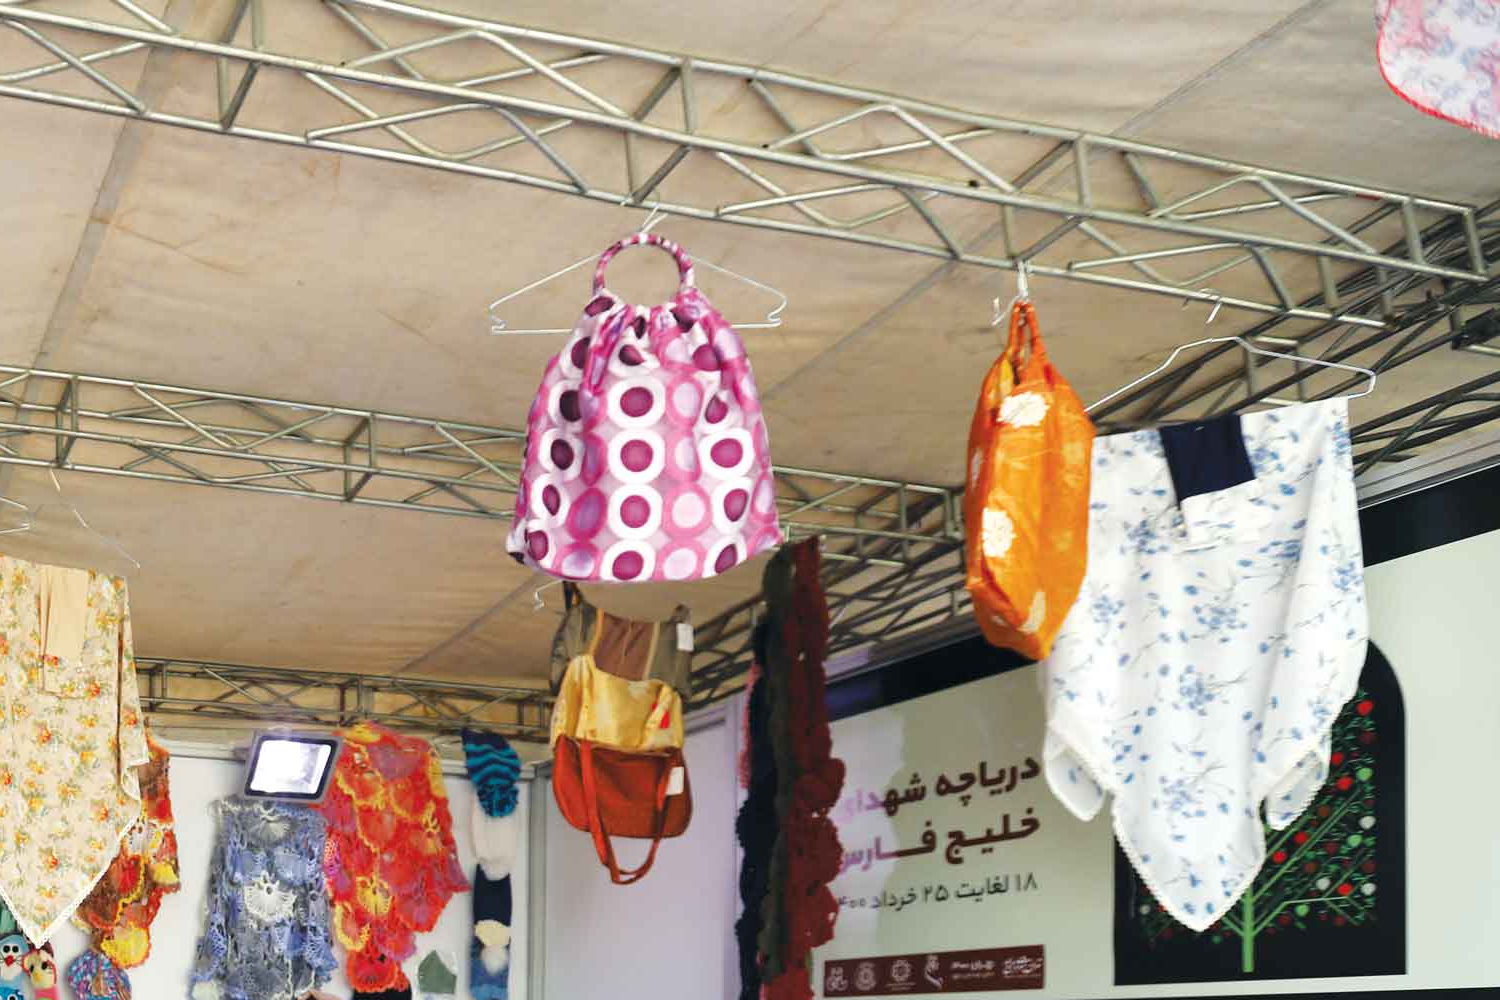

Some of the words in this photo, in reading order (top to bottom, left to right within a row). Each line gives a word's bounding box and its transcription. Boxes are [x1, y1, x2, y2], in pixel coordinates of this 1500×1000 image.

[936, 757, 1040, 807] دریاچه
[838, 820, 937, 875] فارس
[945, 807, 1041, 865] خلیج
[924, 885, 949, 902] ۲۵
[956, 875, 1010, 902] لغایت
[1016, 872, 1039, 891] ۱۸
[871, 887, 918, 911] خرداد
